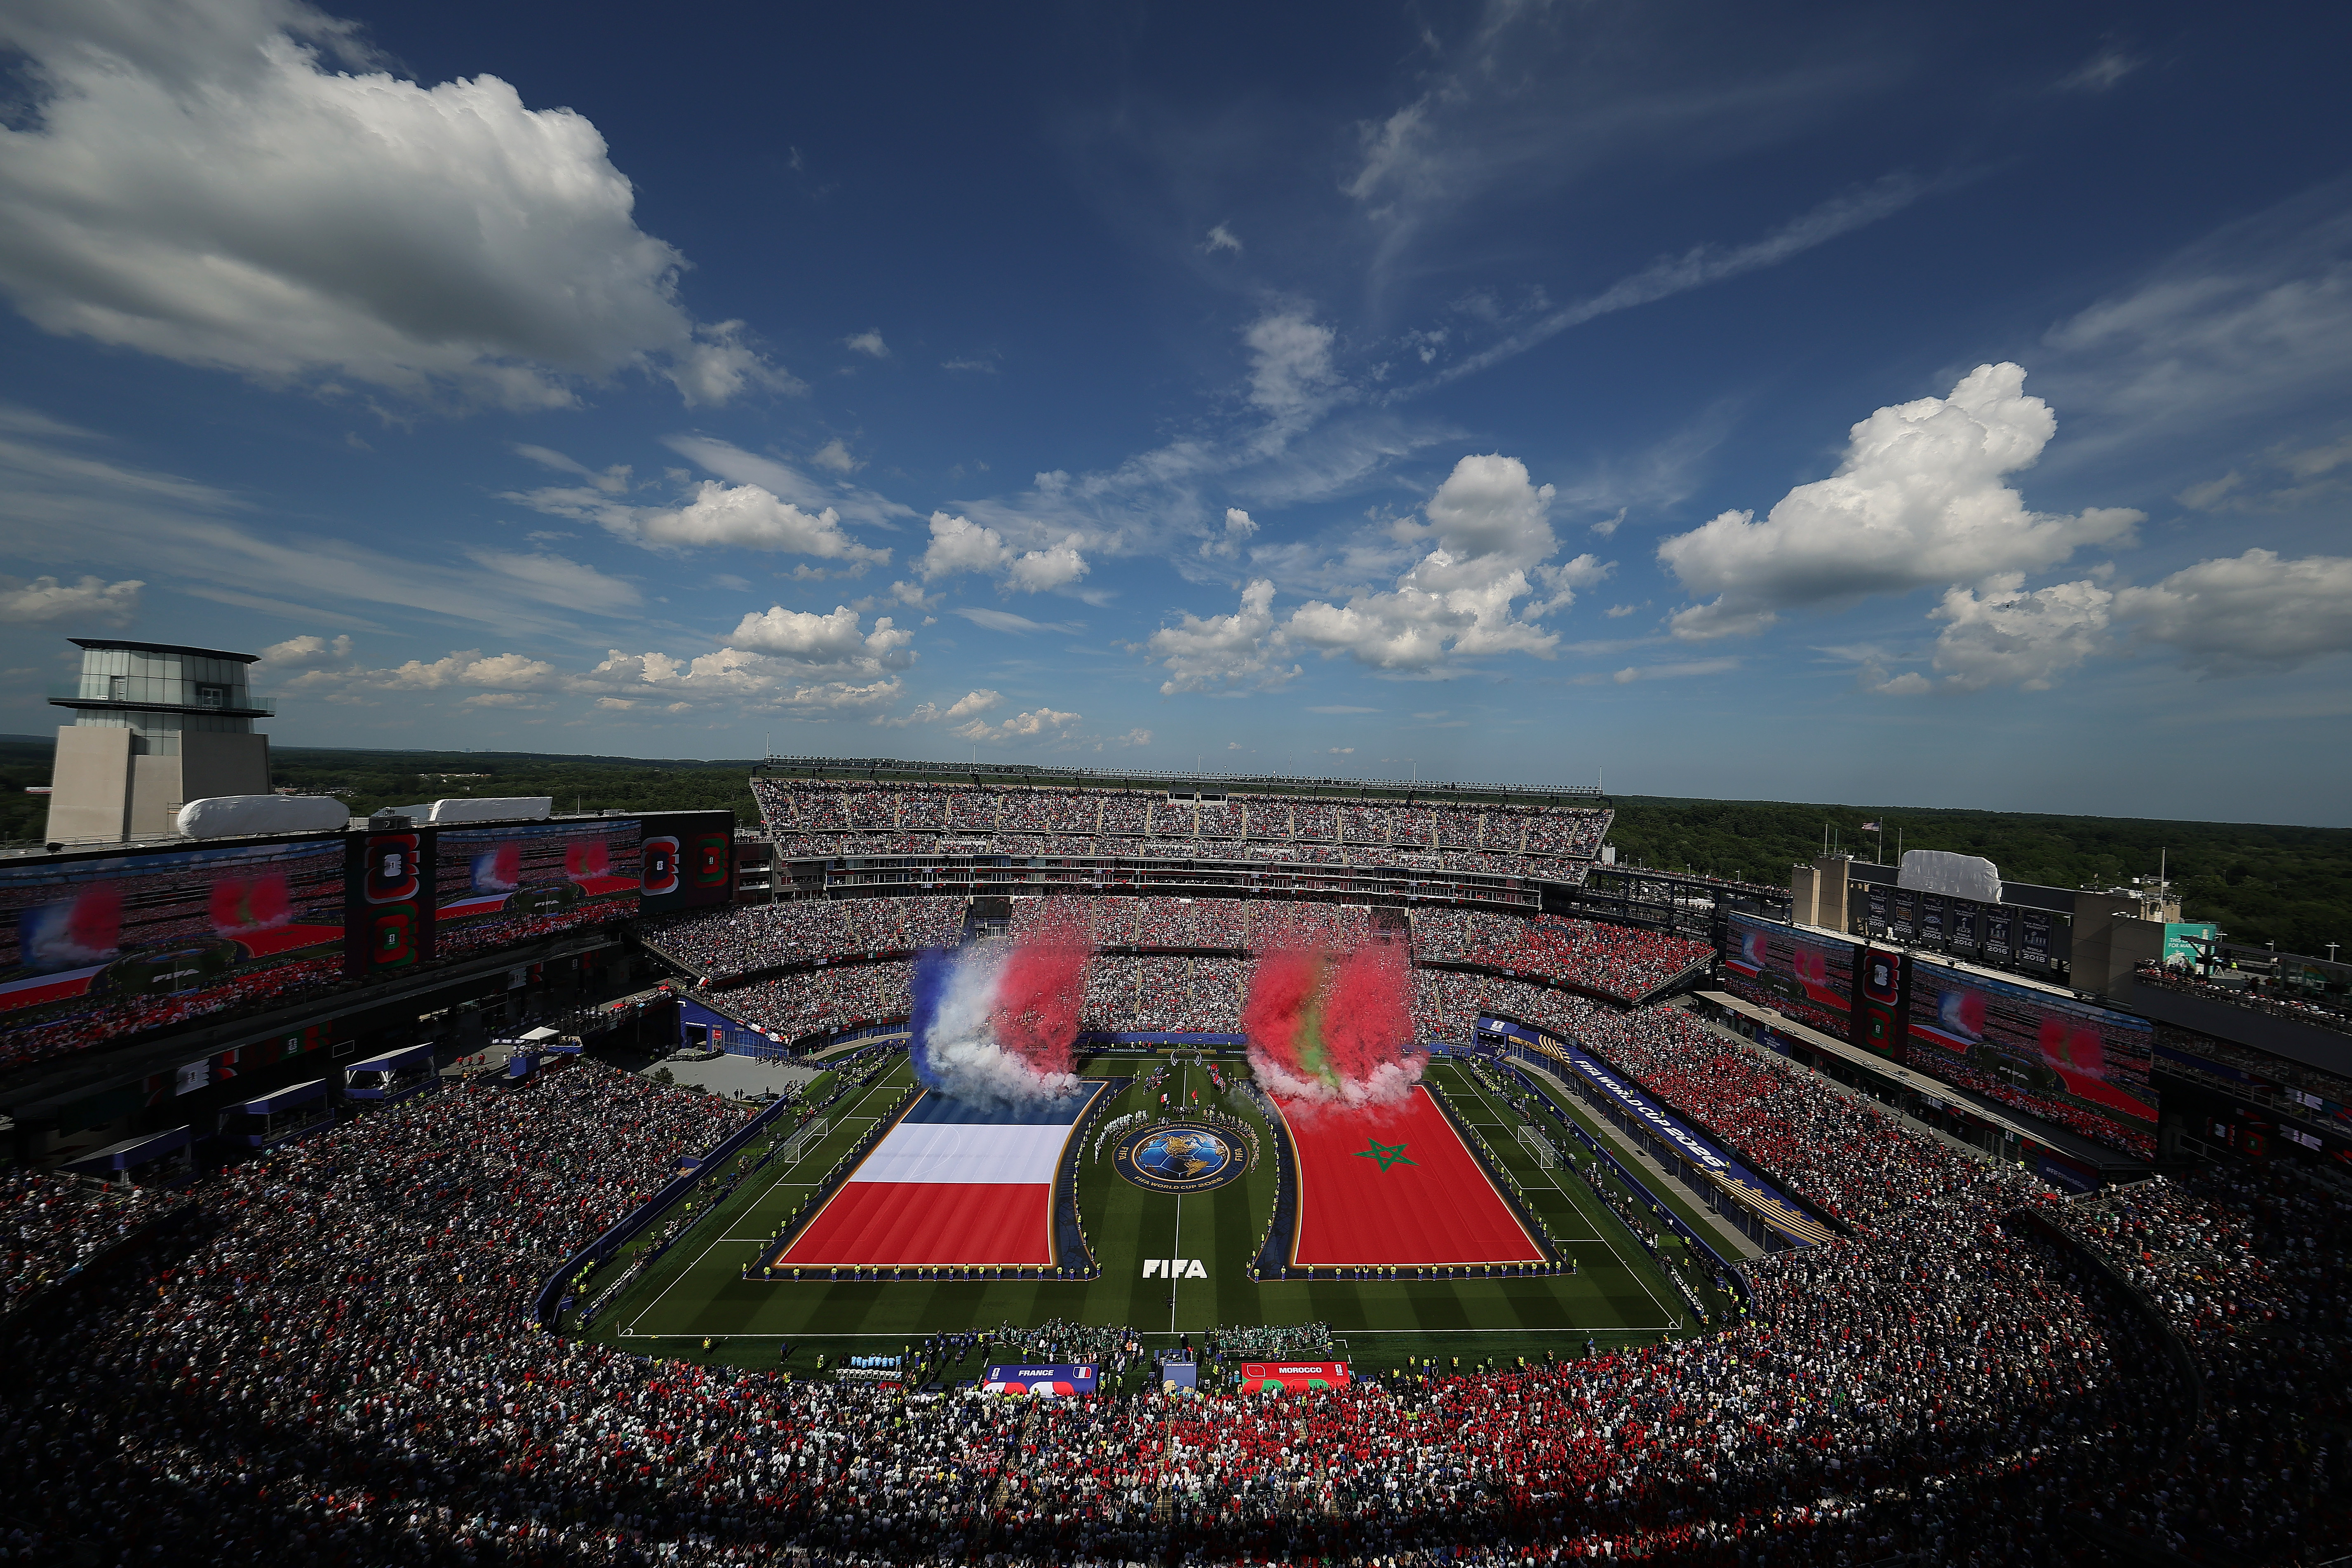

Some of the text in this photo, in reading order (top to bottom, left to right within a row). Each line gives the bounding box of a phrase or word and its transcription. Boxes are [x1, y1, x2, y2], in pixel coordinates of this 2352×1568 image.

[1922, 932, 1941, 940] 2004
[1953, 938, 1973, 947] 2014
[1987, 946, 2008, 955] 2016
[2023, 953, 2046, 962] 2018
[1574, 1060, 1726, 1167] FIFA WORLD CUP 2026
[1118, 1146, 1130, 1160] FIFA
[1234, 1148, 1243, 1162] FIFA
[1134, 1176, 1149, 1185] FIFA
[1198, 1176, 1224, 1188] 2026
[622, 1219, 634, 1231] FIFA
[669, 1203, 716, 1246] FIFA WORLD CUP 2026
[1612, 1209, 1623, 1222] WORLD
[1629, 1227, 1641, 1242] 2026
[1142, 1259, 1208, 1279] FIFA
